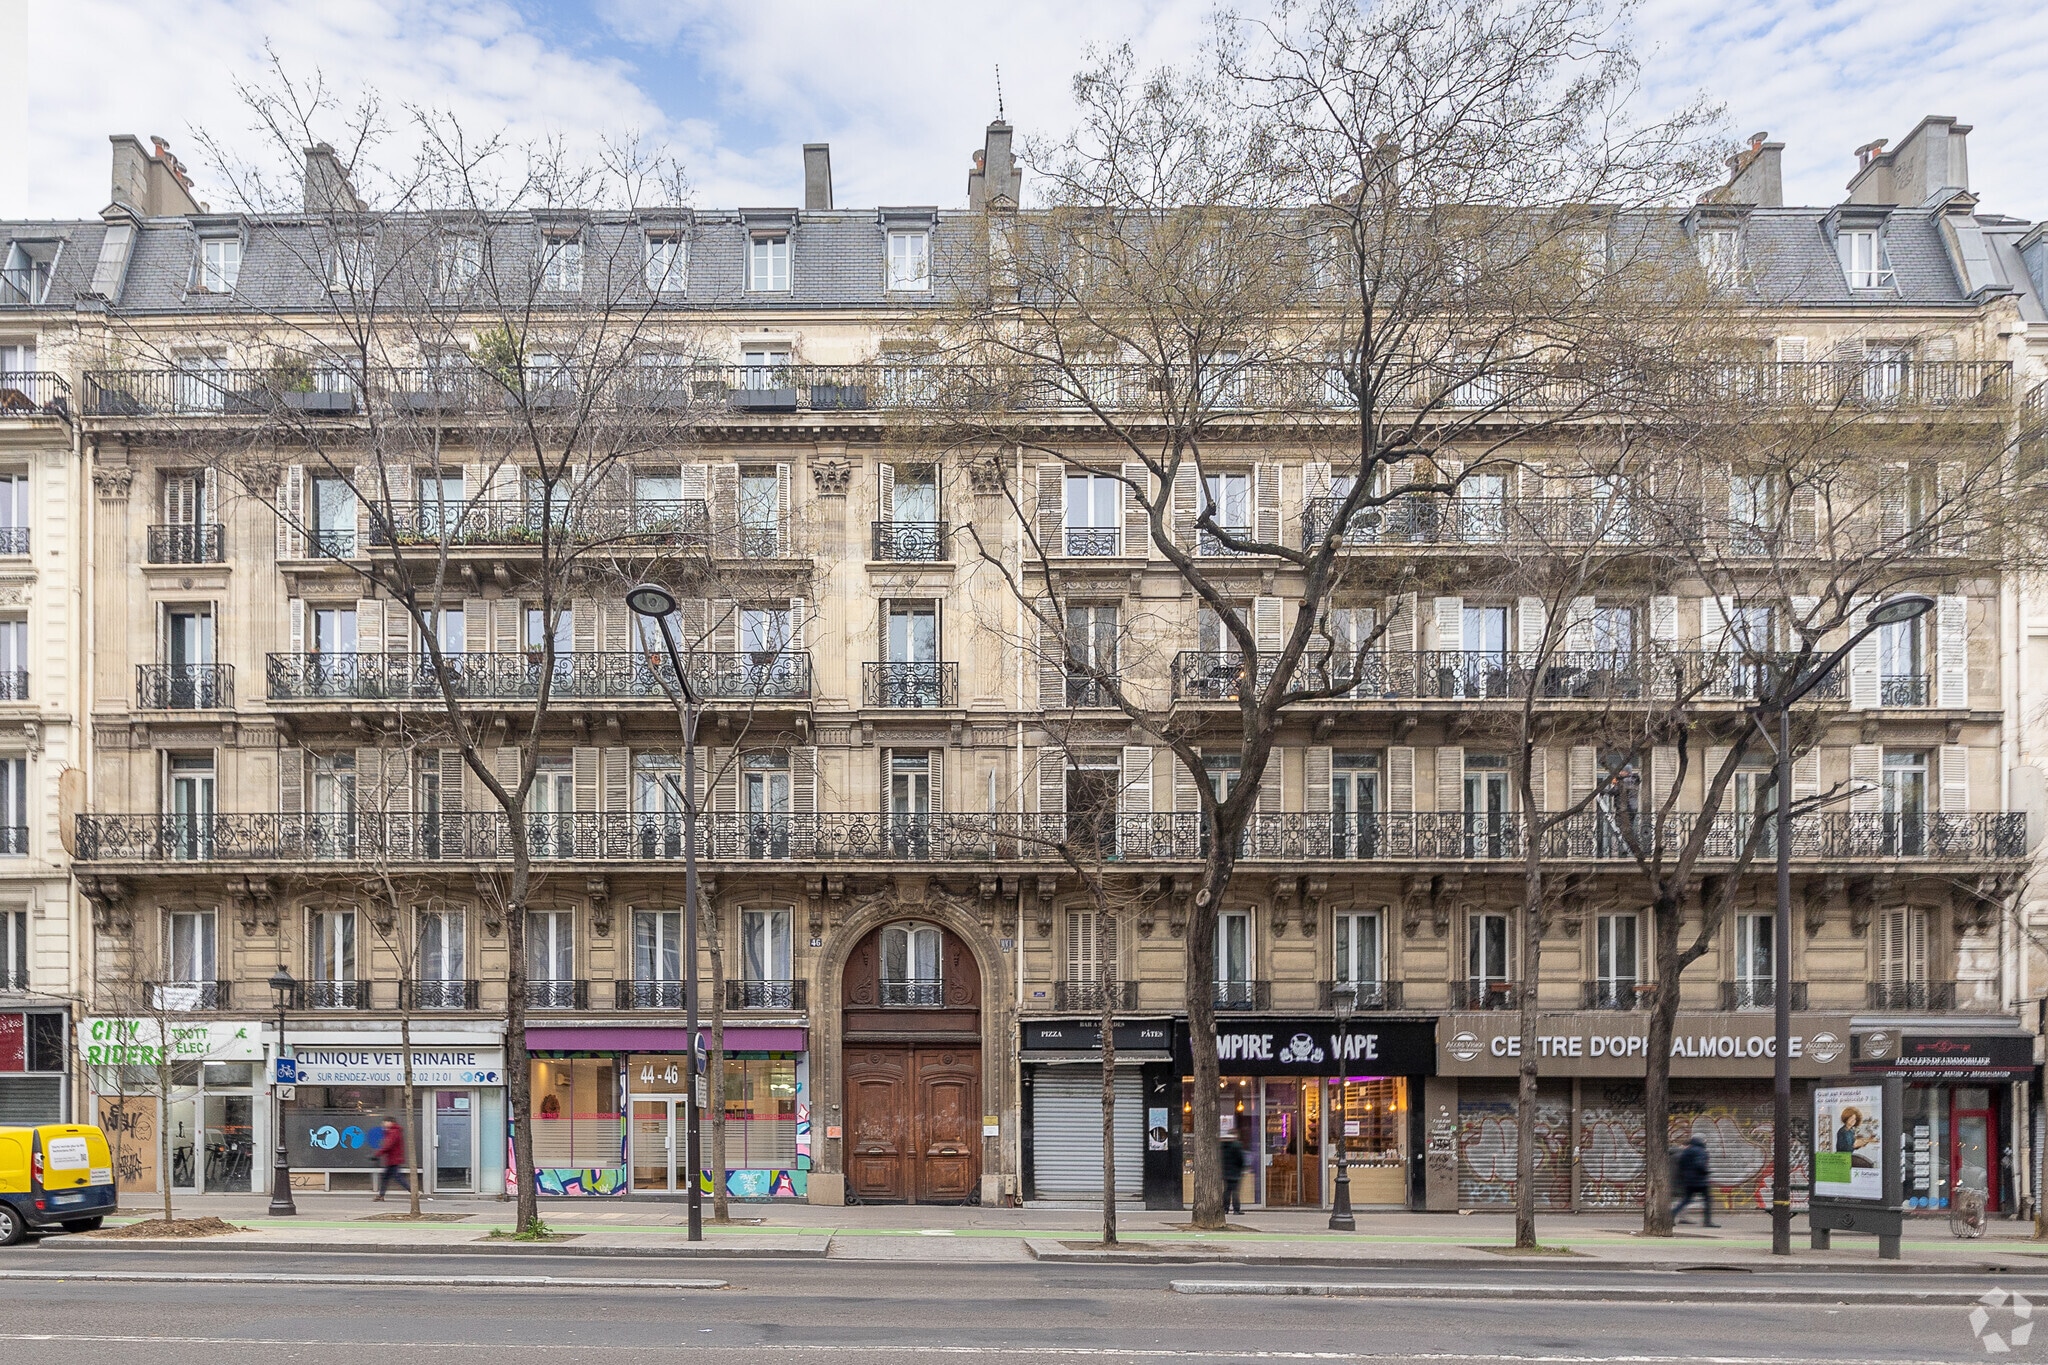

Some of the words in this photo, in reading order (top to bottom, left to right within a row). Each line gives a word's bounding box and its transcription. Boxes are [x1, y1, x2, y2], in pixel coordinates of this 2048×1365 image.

[811, 939, 821, 947] 46
[91, 1020, 140, 1041] CITY
[1041, 1030, 1063, 1038] PIZZA
[1140, 1028, 1164, 1038] PÂTES
[1189, 1033, 1274, 1060] MPIRE
[1330, 1033, 1379, 1060] VAPE
[1490, 1035, 1583, 1058] CETRE
[296, 1052, 369, 1067] CLINIQUE
[373, 1052, 476, 1065] VETRINAIRE
[317, 1072, 332, 1081] SUR
[334, 1072, 391, 1081] RENDEZ-VOUS
[419, 1072, 429, 1081] 02
[432, 1072, 441, 1081] 12
[442, 1072, 452, 1081] 01
[640, 1065, 655, 1084] 44
[664, 1065, 678, 1084] 46
